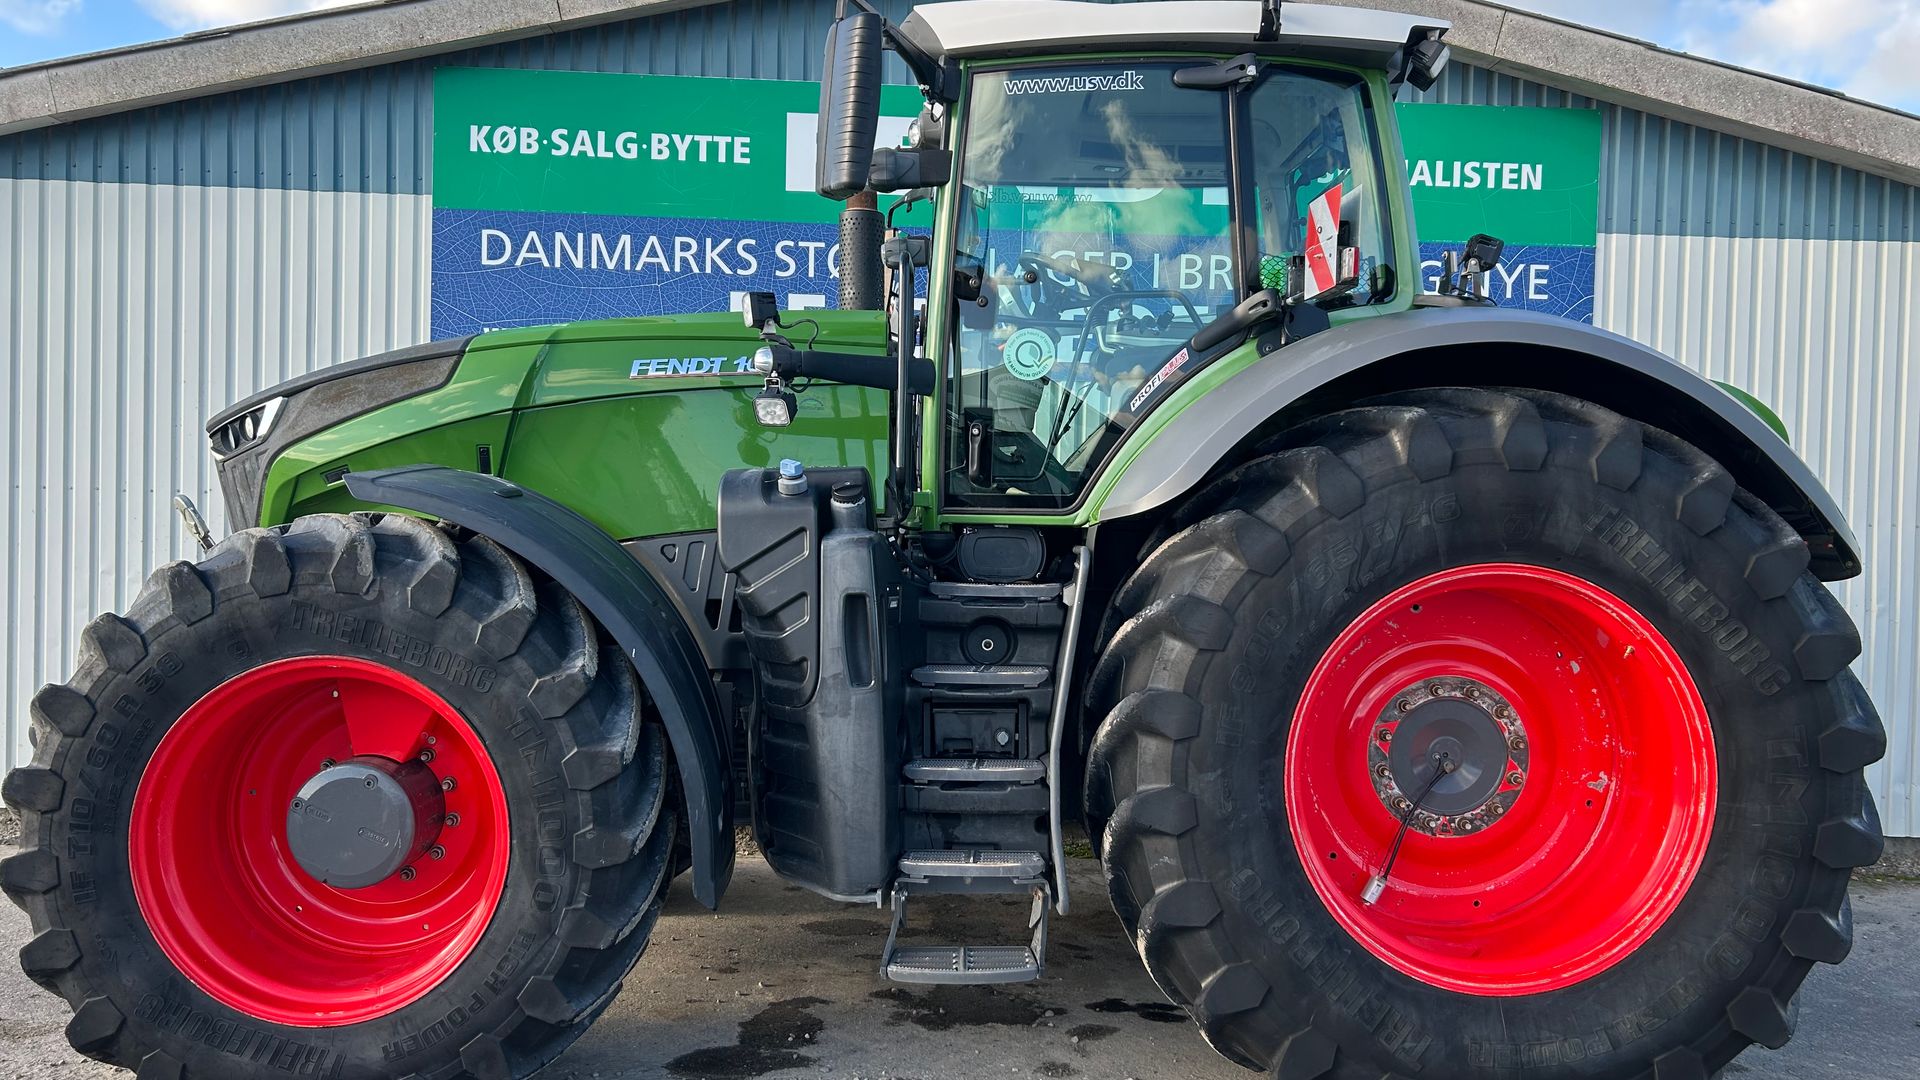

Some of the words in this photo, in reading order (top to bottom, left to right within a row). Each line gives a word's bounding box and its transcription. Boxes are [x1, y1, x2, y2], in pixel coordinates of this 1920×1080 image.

[1004, 71, 1144, 95] www.usv.dk
[1405, 159, 1543, 191] ALISTEN
[480, 228, 759, 277] DANMARKS
[630, 357, 728, 379] FENDT
[1031, 363, 1050, 378] QUALITY
[1584, 502, 1792, 697] TRELLEBORG
[290, 598, 498, 695] TRELLEBORG
[382, 990, 489, 1063] POWER
